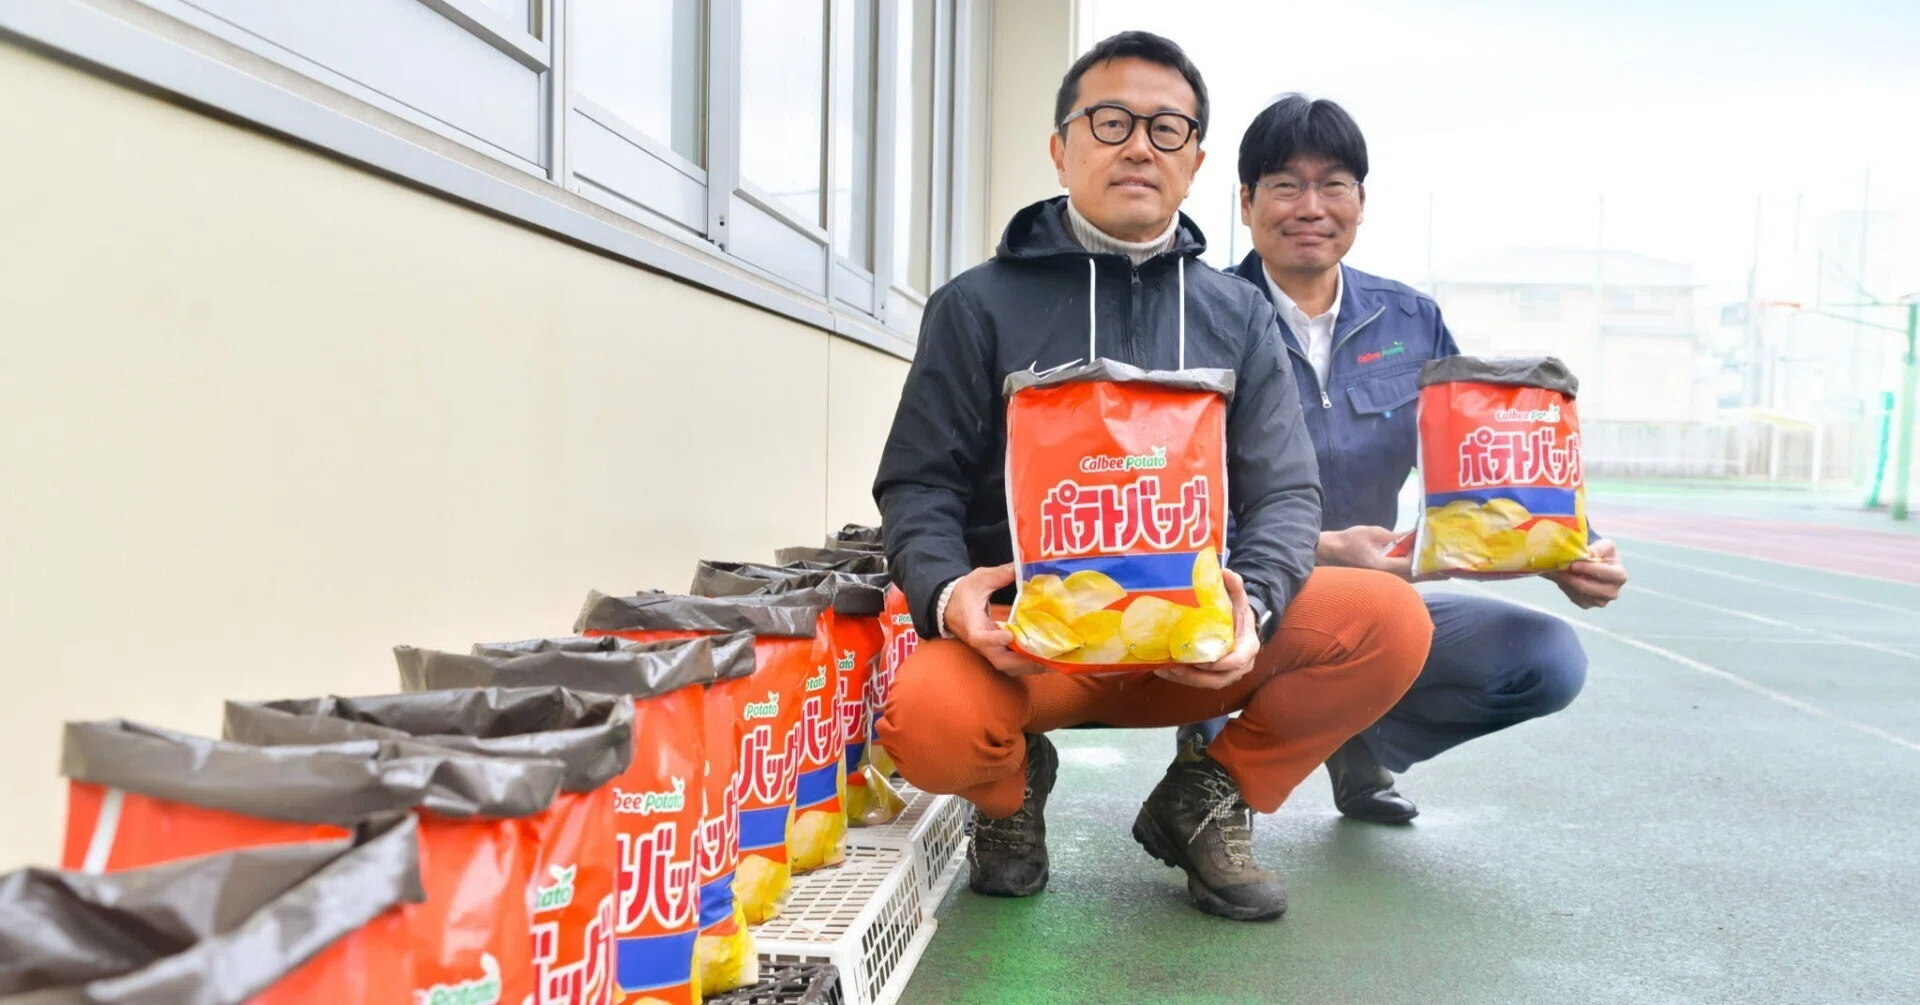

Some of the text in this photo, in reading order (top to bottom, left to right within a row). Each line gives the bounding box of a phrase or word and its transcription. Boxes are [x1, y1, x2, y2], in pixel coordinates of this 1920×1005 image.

[1080, 455, 1166, 472] Calbee Potato
[1459, 426, 1582, 487] ポテトバッグ
[1041, 475, 1210, 556] ポテトバッグ
[745, 703, 779, 720] Potato
[643, 793, 684, 814] Potato
